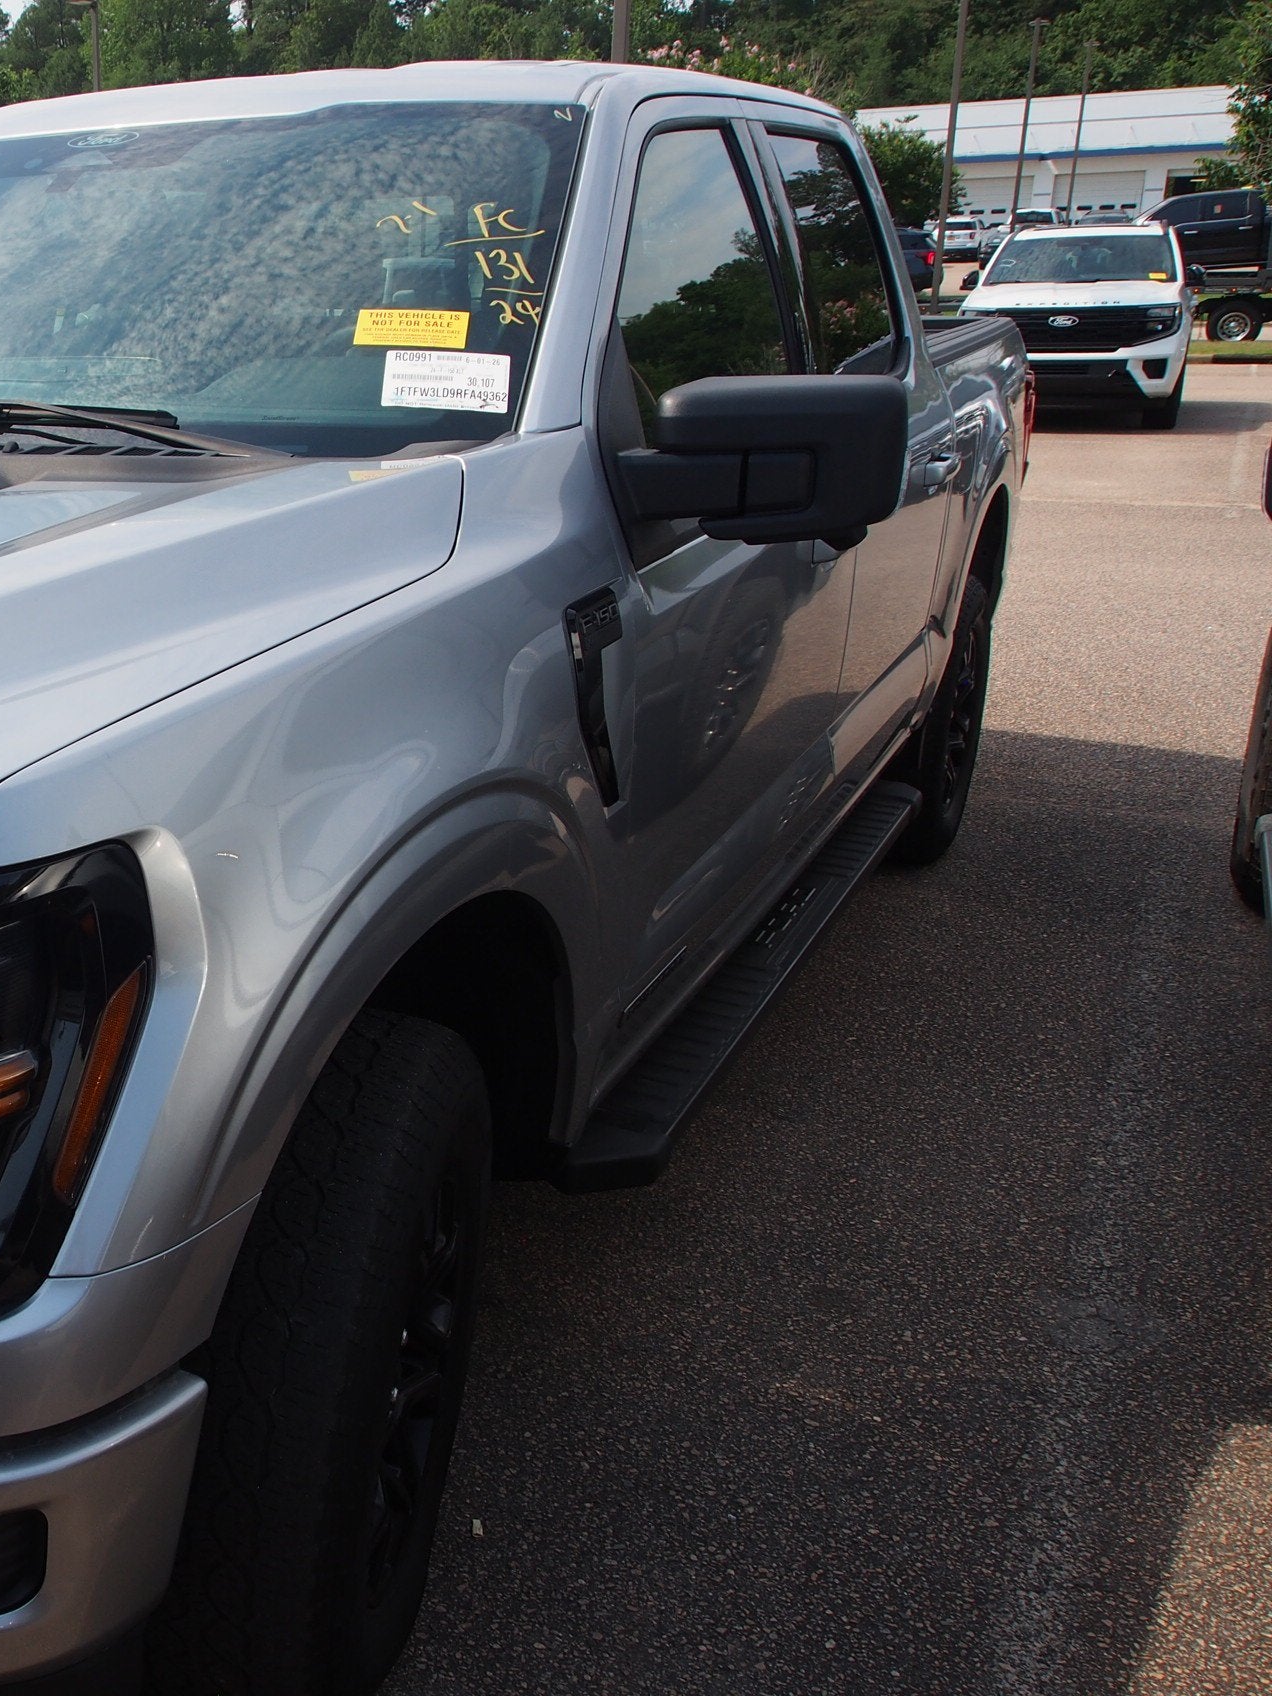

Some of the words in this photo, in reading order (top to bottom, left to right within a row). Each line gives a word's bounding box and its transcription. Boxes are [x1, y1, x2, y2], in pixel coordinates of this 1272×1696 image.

[474, 249, 535, 284] 131
[369, 311, 394, 319] THIS
[398, 311, 445, 320] VEHICLE
[449, 313, 460, 321] IS
[424, 320, 453, 328] SALE
[394, 351, 433, 362] RC0991
[580, 603, 619, 633] F-150
